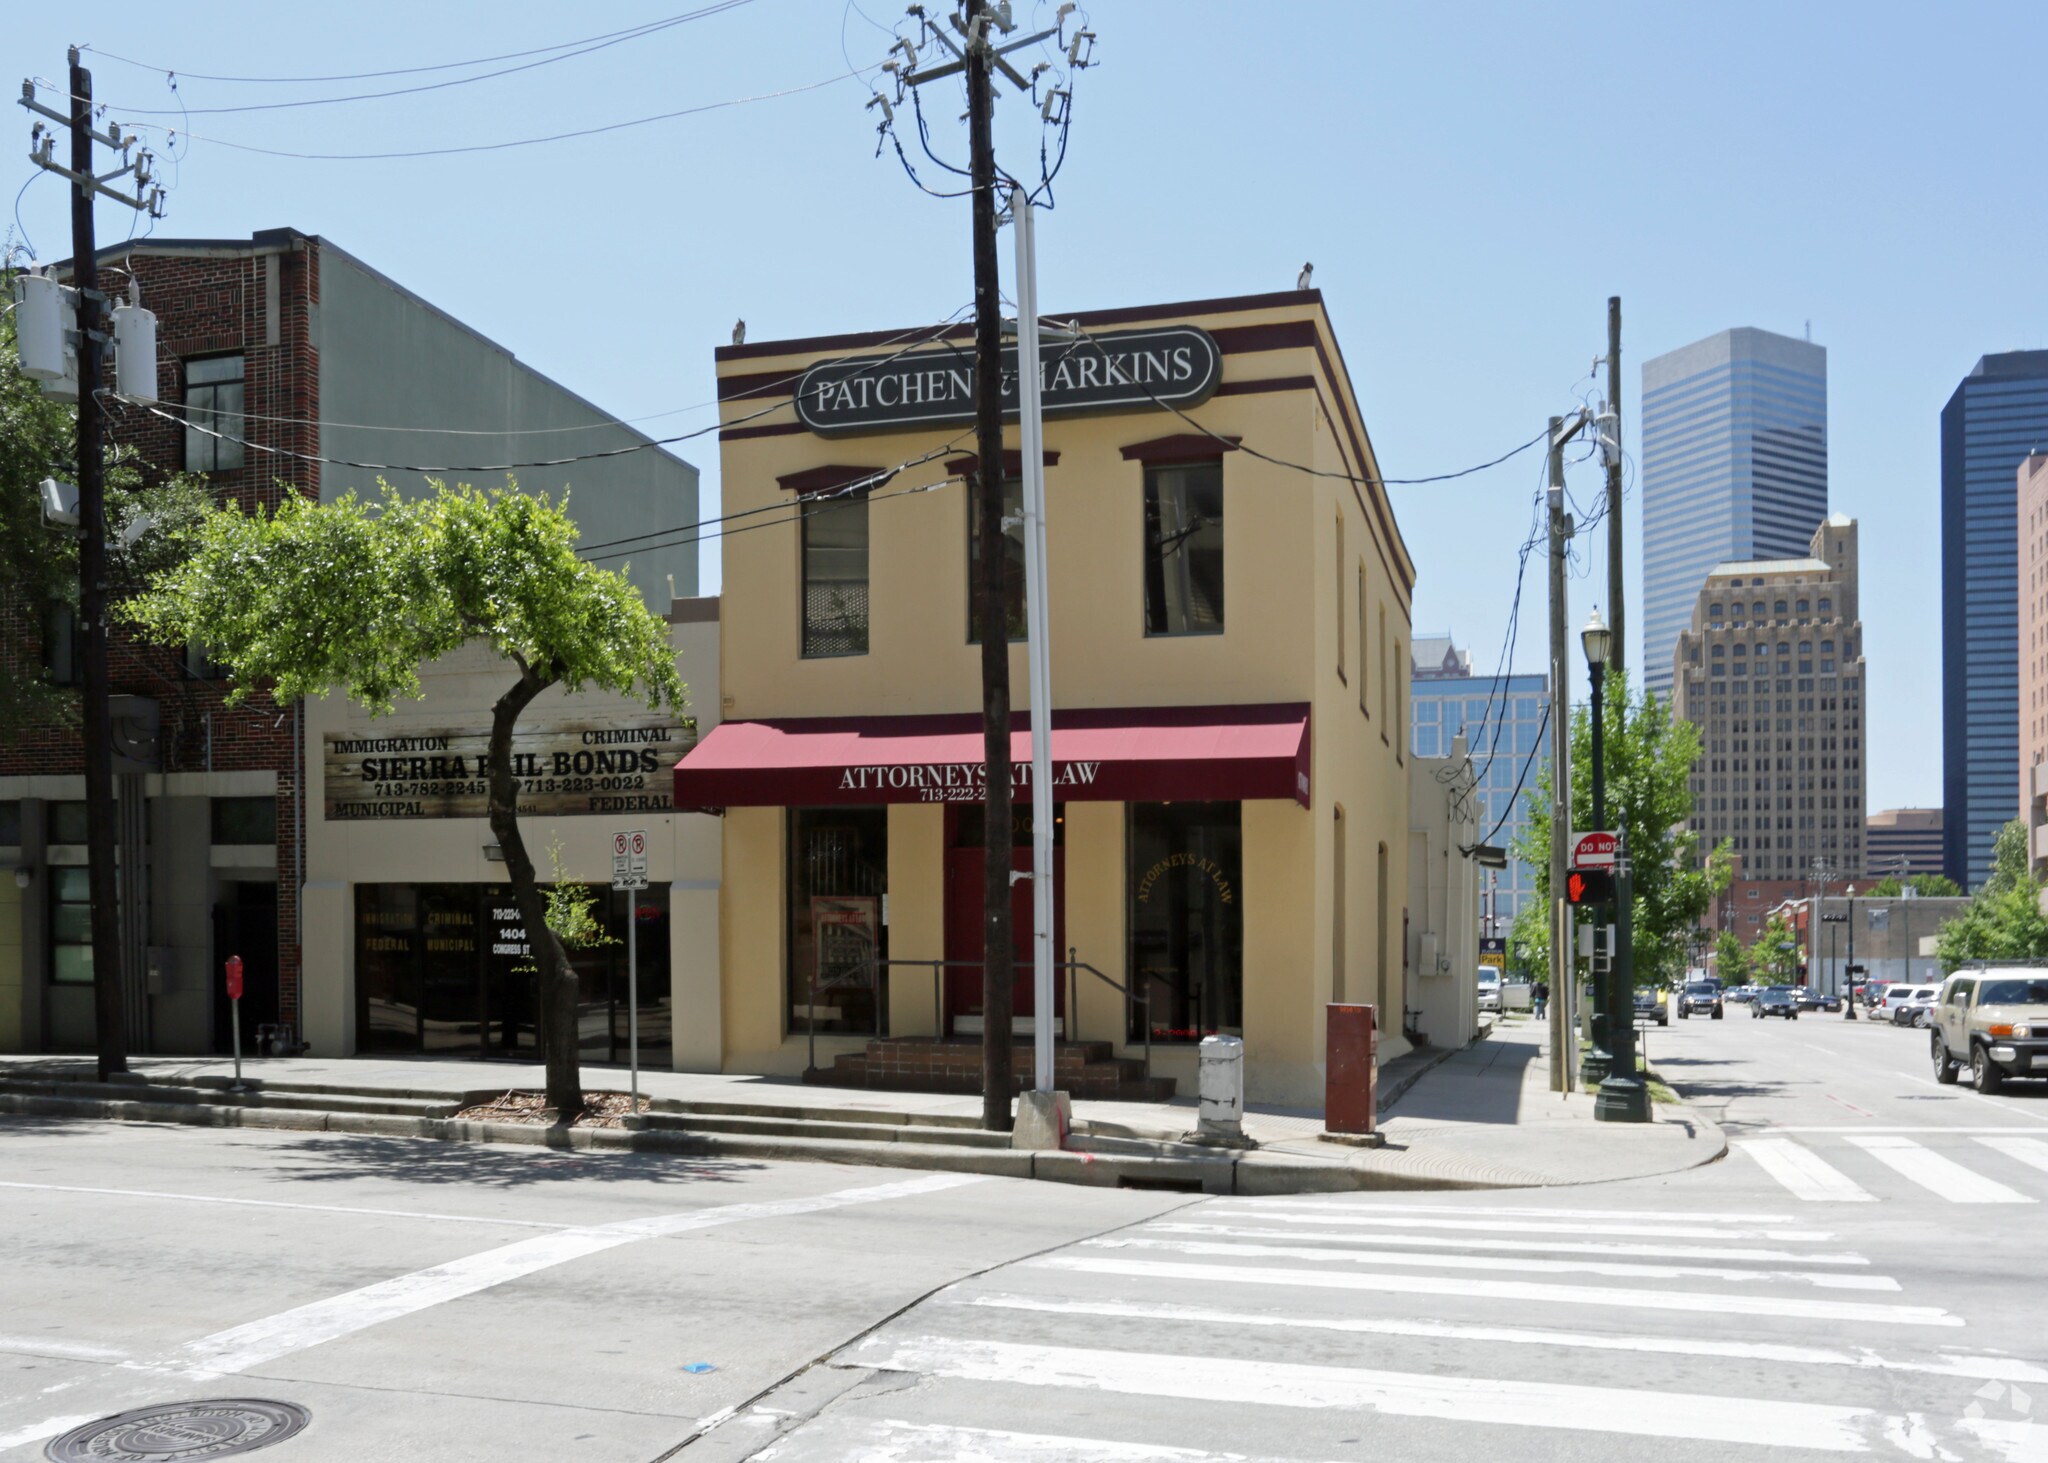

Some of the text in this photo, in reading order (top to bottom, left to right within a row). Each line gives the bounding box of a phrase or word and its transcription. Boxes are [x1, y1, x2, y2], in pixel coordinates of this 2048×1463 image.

[815, 368, 974, 412] PATCHEN
[582, 728, 672, 745] CRIMINAL
[333, 736, 449, 755] IMMIGRATION
[361, 748, 659, 782] SIERRA BIL BONDS
[374, 776, 645, 797] 713-782-2245 713-223-0022
[335, 801, 425, 818] MUNICIPAL
[588, 796, 674, 812] FEDERAL
[1580, 841, 1617, 852] DO NOT
[1138, 852, 1233, 904] ATTORNEYS AT LAW
[427, 913, 475, 925] CRIMINAL
[499, 928, 527, 940] 1404
[365, 938, 409, 950] FEDERAL
[1481, 955, 1502, 964] Park
